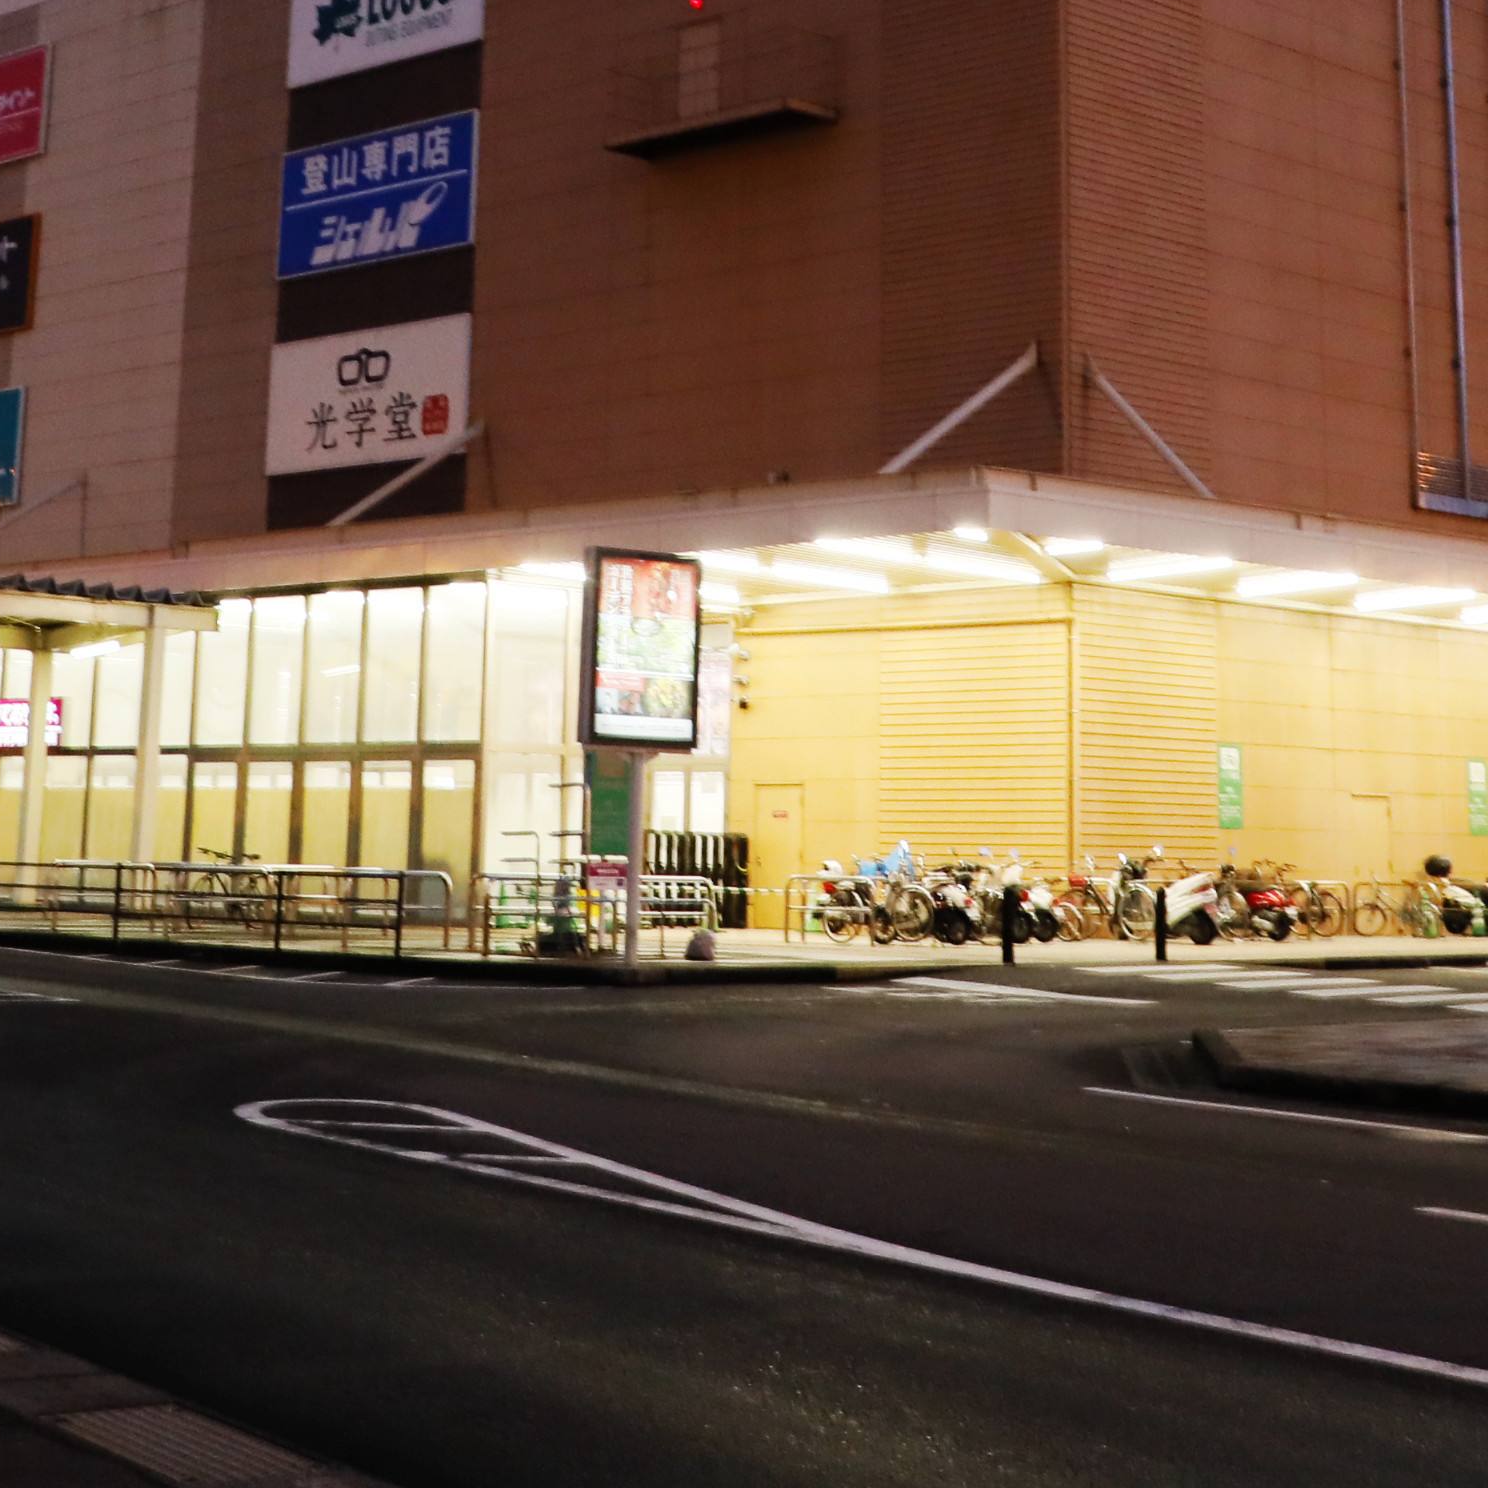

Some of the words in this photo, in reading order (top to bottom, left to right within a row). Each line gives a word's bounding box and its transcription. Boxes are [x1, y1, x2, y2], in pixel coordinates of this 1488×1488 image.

[301, 125, 452, 195] 登山専門店
[306, 391, 418, 453] 光学堂
